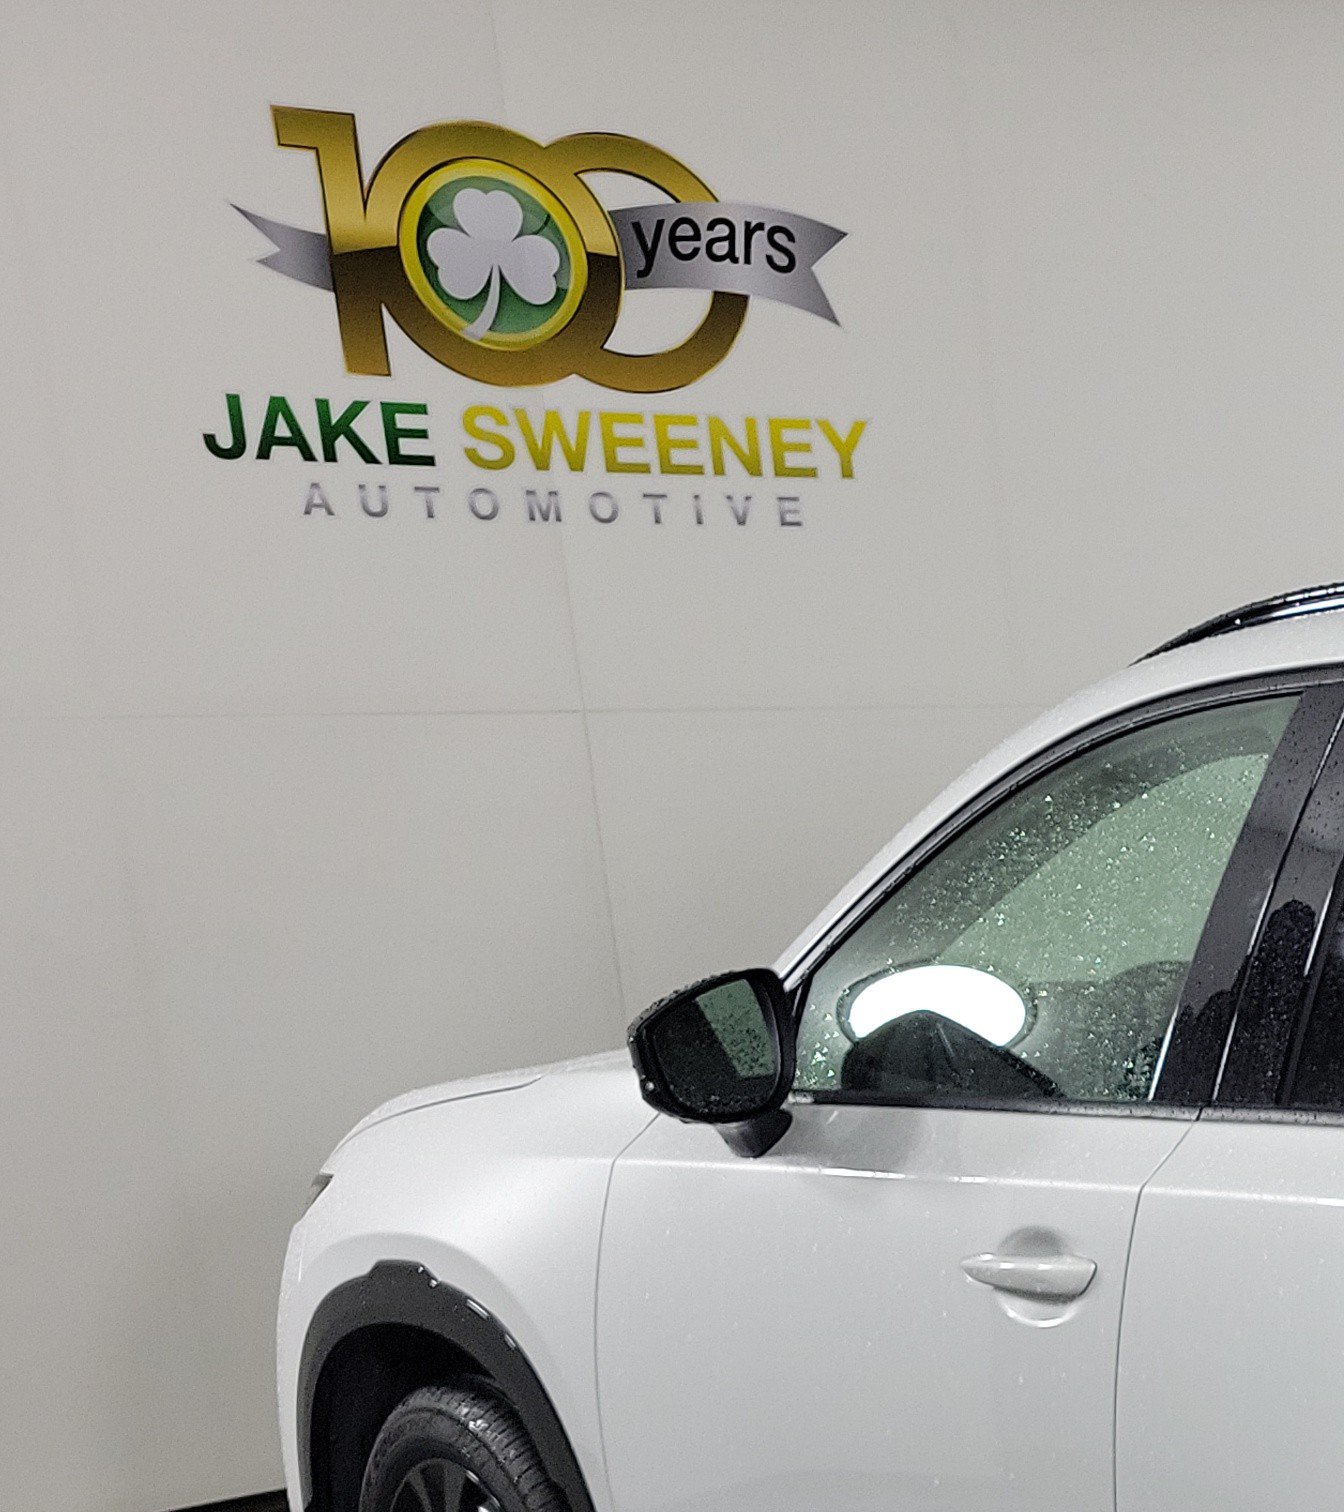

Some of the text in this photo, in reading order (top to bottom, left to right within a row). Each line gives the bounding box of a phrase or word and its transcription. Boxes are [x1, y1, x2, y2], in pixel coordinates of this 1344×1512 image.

[270, 105, 797, 392] 100 years
[202, 393, 868, 479] JAKE SWEENEY
[303, 482, 803, 526] AUTOMOTIVE
